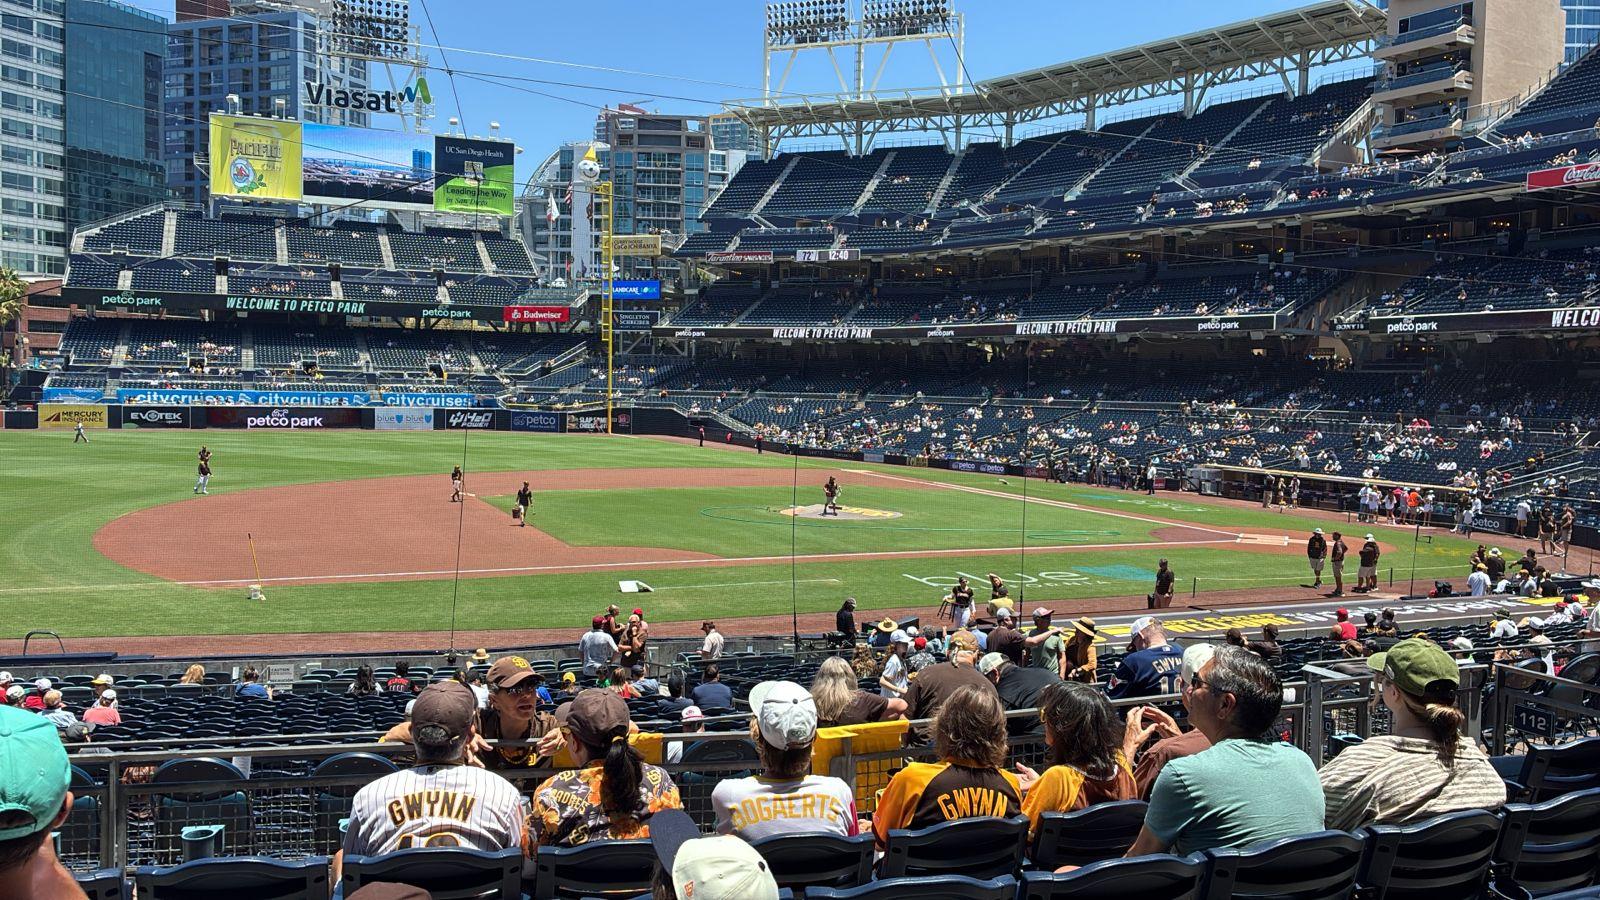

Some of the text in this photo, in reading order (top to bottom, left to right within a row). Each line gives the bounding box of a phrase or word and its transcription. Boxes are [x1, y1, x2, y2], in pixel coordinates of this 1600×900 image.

[305, 82, 396, 113] Viasat
[445, 146, 504, 158] UC San Diego Health
[446, 187, 476, 197] Leading
[490, 190, 507, 199] Way
[828, 250, 849, 261] 12:40
[102, 294, 162, 307] petco park
[226, 297, 366, 314] WELCOME TO PETCO PARK
[422, 308, 472, 319] petco park
[523, 309, 562, 319] Budweiser
[1551, 309, 1600, 327] WELCO
[1015, 320, 1118, 334] WELCOME TO PETCO PARK
[1197, 320, 1240, 331] petco park
[1387, 320, 1438, 334] petco park
[675, 329, 706, 338] petco park
[772, 328, 873, 339] WELCOME TO PETCO PARK
[926, 328, 955, 338] petco park
[258, 393, 349, 406] citycruises
[387, 394, 471, 407] citycruises
[247, 416, 323, 429] petco park
[526, 414, 556, 427] petco
[958, 462, 976, 470] petco
[987, 464, 1005, 472] petco
[1472, 517, 1500, 529] petco
[1152, 657, 1182, 674] GWYN
[1519, 712, 1546, 731] 112
[550, 788, 591, 815] PADRES
[937, 787, 1009, 821] GWYNN
[387, 789, 477, 828] GWYNN
[729, 792, 842, 831] BOGAERTS
